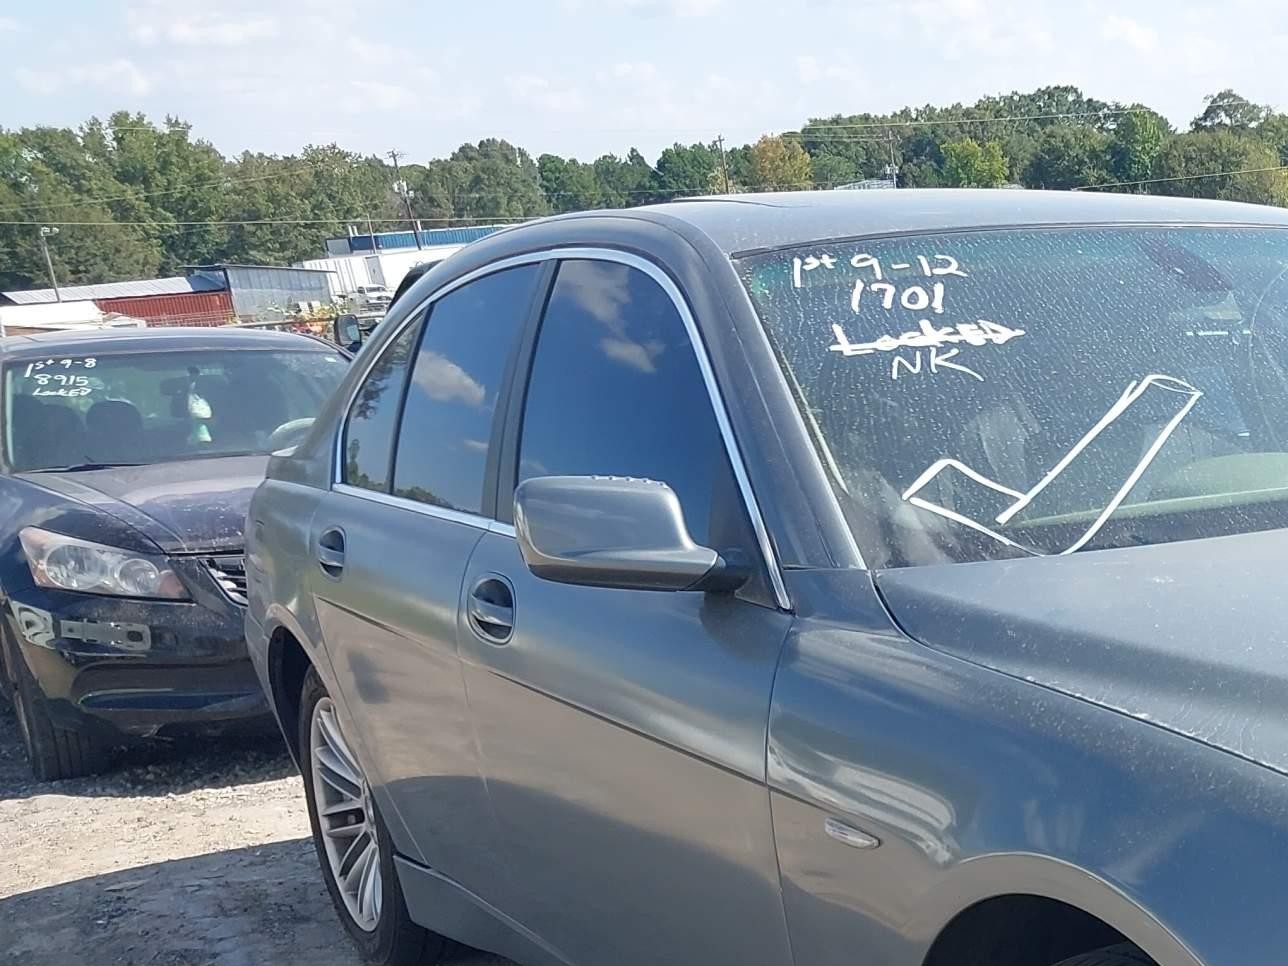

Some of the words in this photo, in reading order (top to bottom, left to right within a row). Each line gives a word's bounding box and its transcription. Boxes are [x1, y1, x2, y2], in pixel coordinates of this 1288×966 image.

[850, 253, 968, 280] 9-12
[851, 279, 945, 314] 1701
[891, 347, 984, 380] NK
[34, 373, 89, 387] 8915
